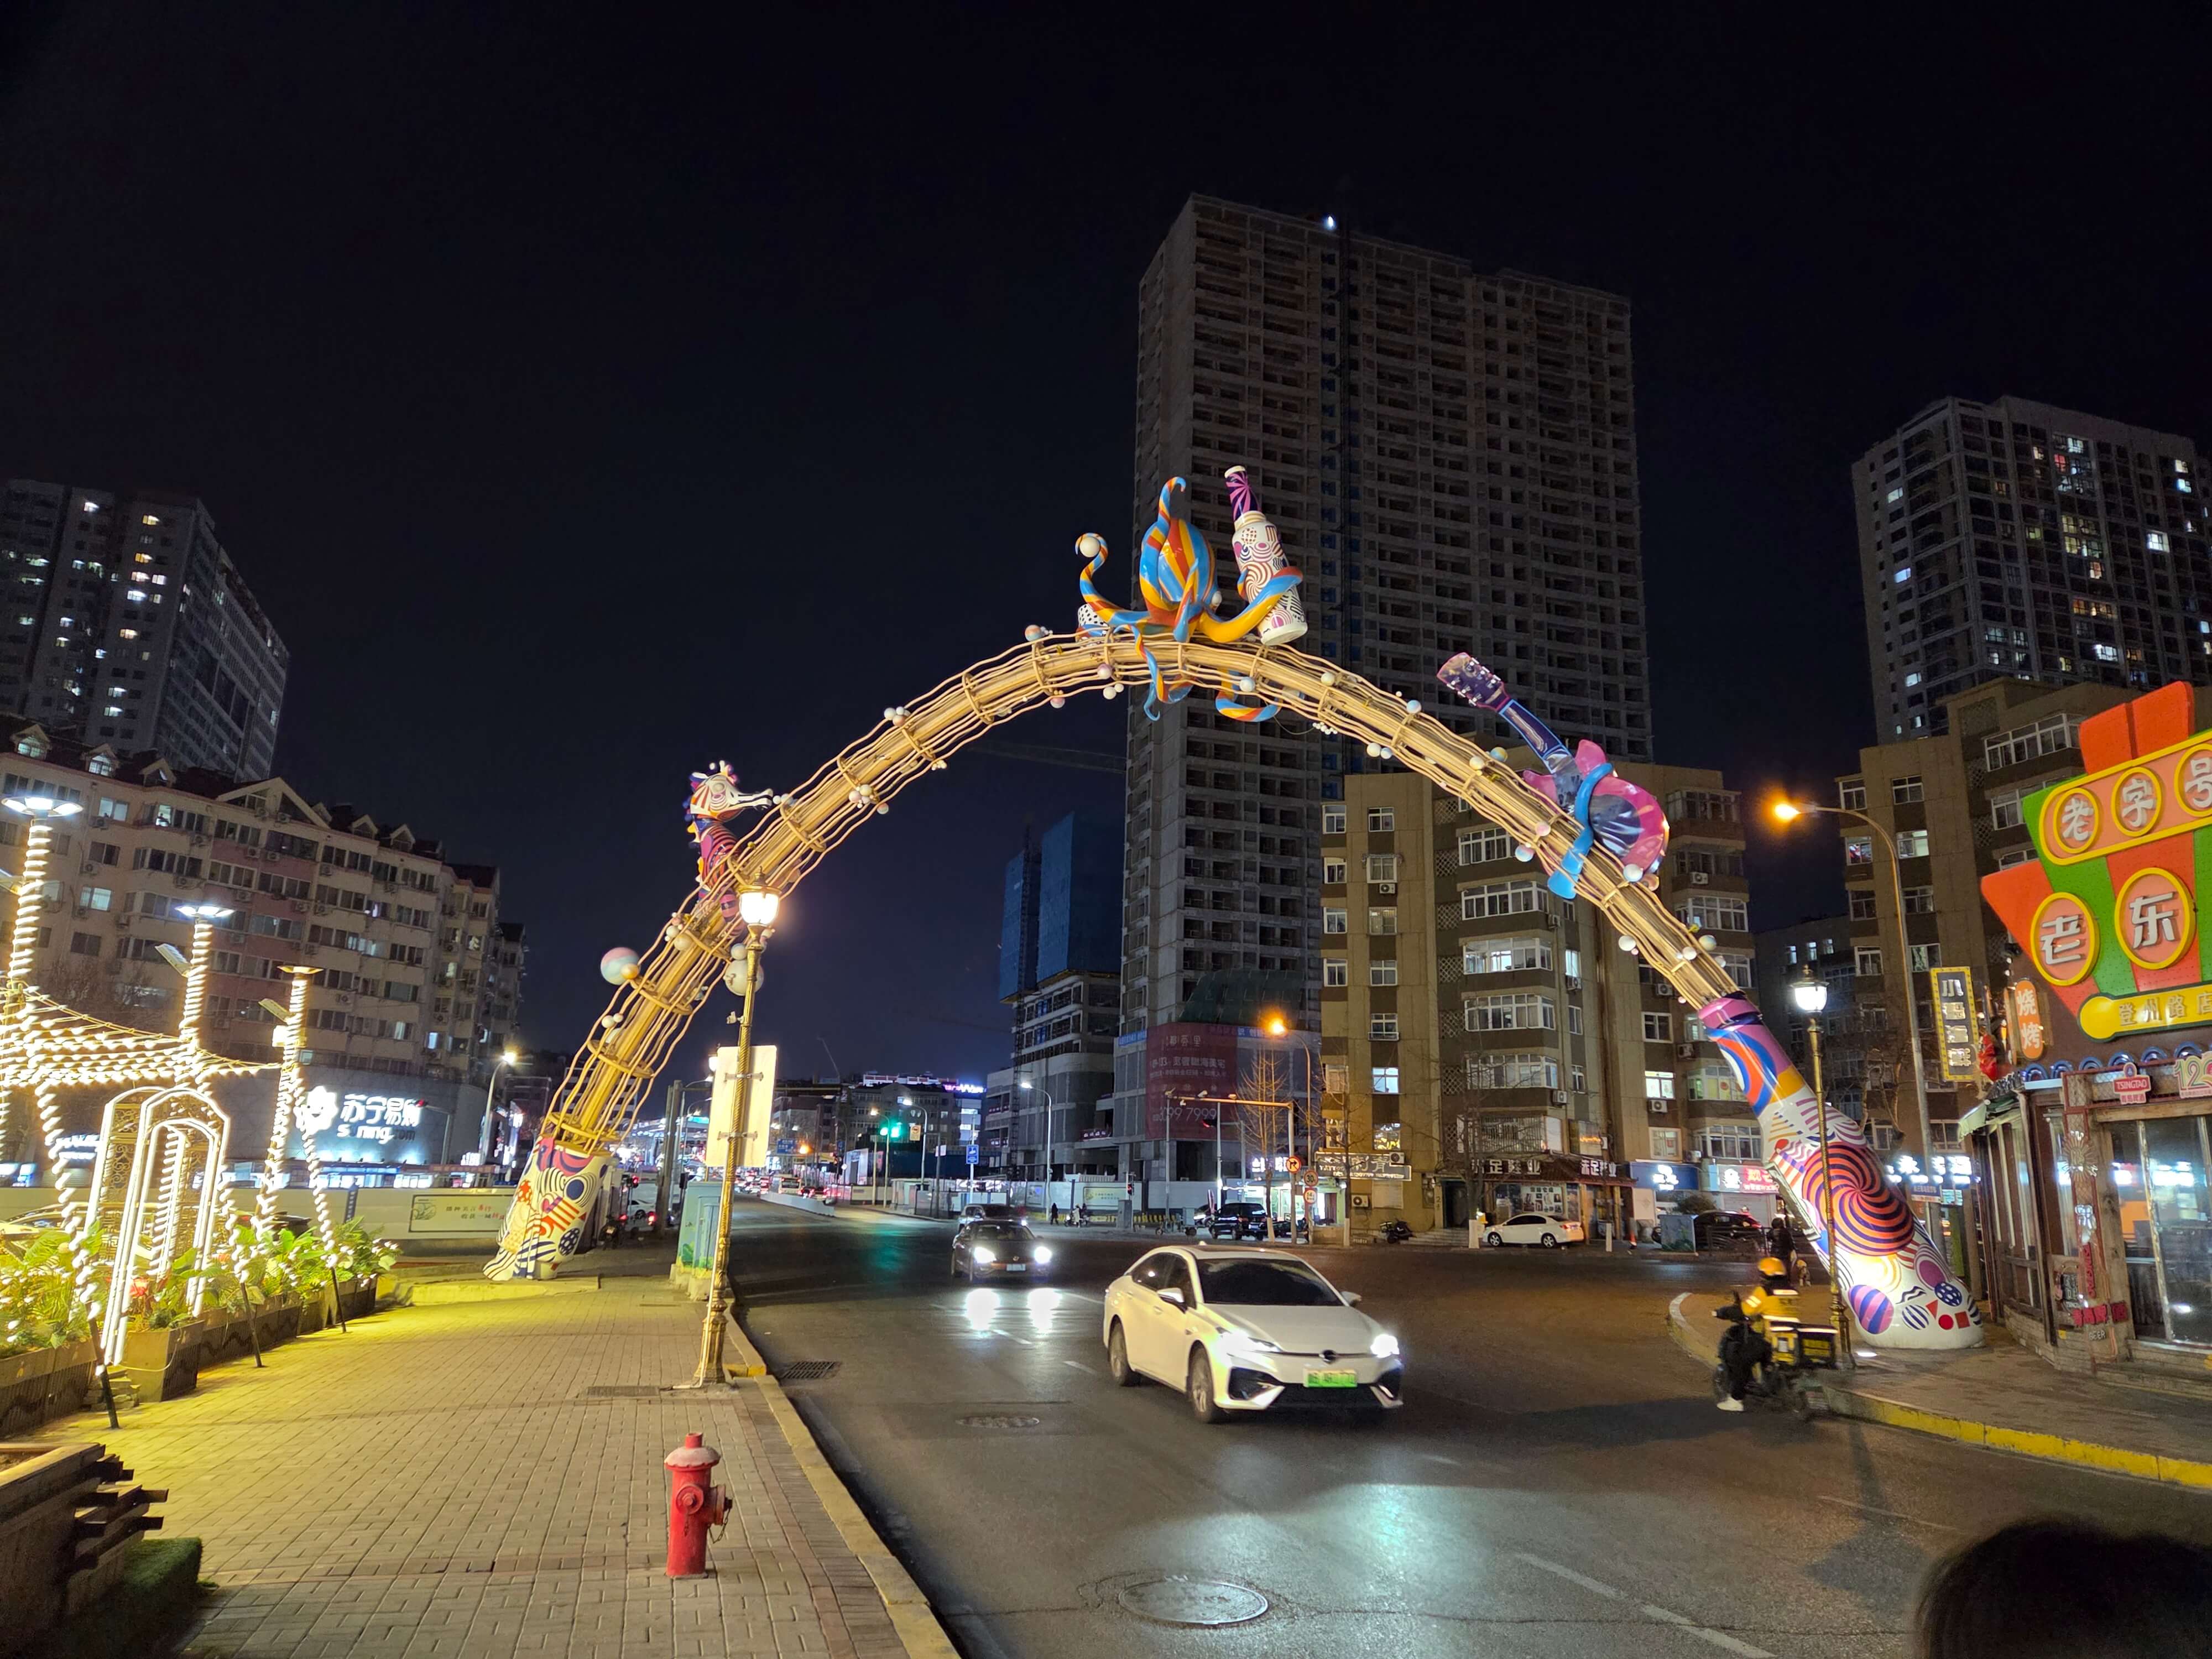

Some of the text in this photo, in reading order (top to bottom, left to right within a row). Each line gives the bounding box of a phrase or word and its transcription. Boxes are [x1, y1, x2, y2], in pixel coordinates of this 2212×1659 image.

[2062, 757, 2212, 841] 老字号
[2041, 892, 2177, 965] 老东
[2017, 989, 2040, 1050] 烧烤
[2119, 991, 2212, 1026] 登州路店
[2116, 1079, 2147, 1089] TSINGTAO
[340, 1093, 422, 1127] 苏宁易购
[2088, 1329, 2106, 1340] BEER
